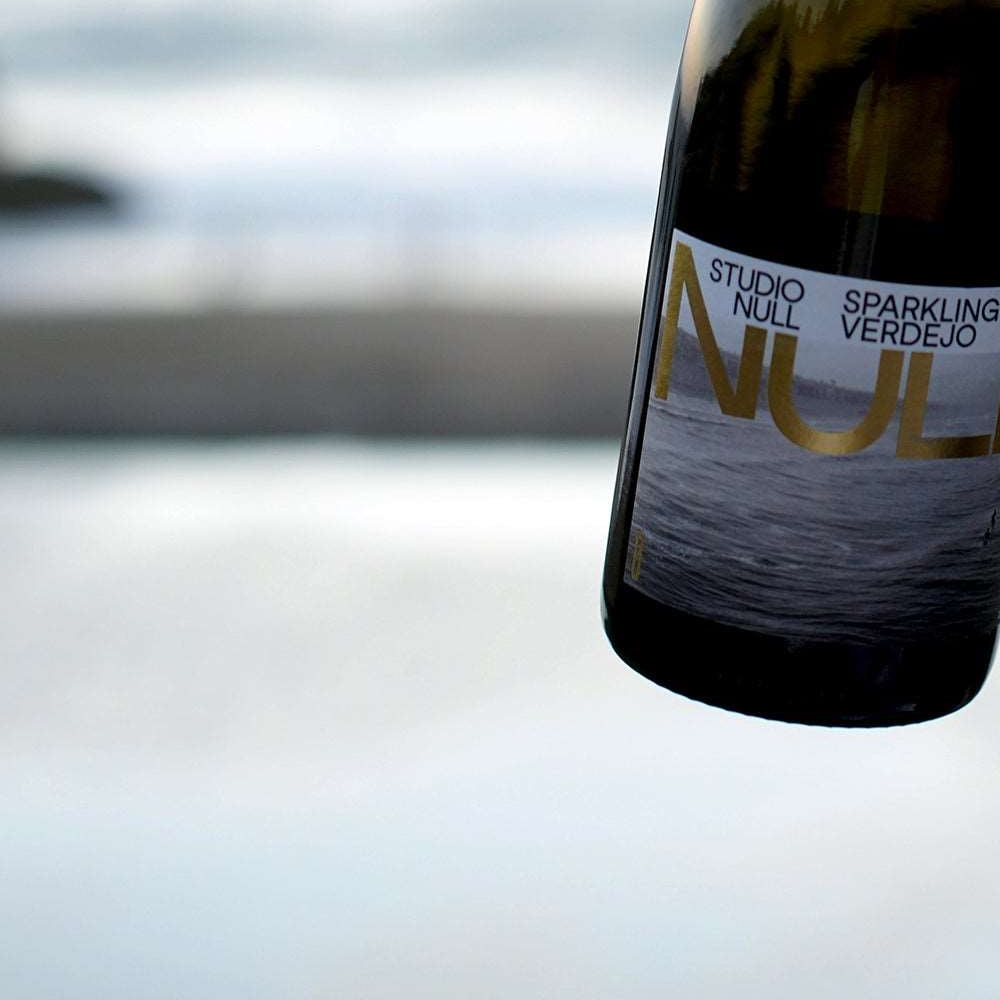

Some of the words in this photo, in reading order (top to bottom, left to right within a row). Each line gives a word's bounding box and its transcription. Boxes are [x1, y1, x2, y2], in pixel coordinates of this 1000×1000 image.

[709, 257, 805, 304] STUDIO
[733, 291, 800, 330] NULL
[842, 289, 1000, 323] SPARKLING
[841, 313, 977, 348] VERDEJO
